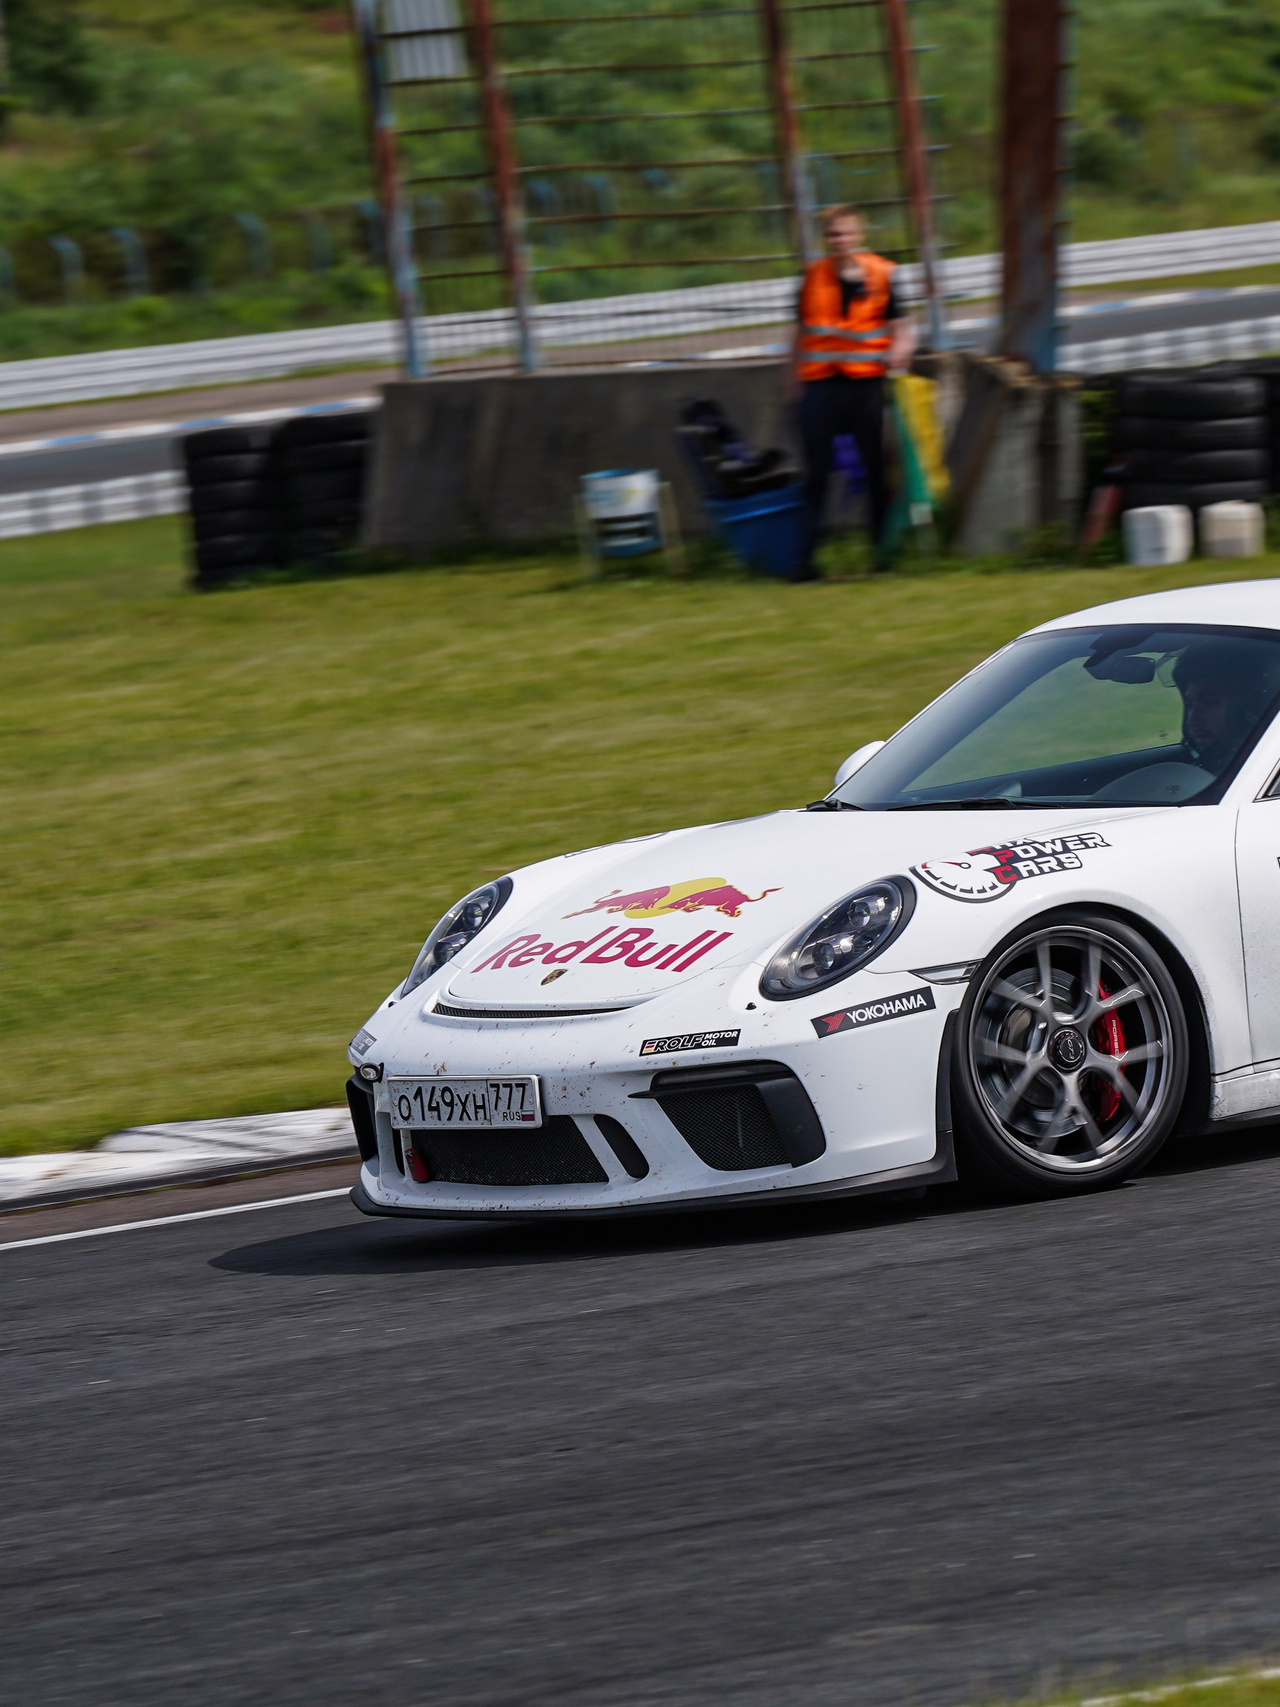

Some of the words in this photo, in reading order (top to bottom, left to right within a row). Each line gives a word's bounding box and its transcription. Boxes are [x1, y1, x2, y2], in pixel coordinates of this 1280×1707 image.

[990, 833, 1111, 863] POWER
[990, 852, 1079, 884] CARS
[846, 994, 927, 1024] YOKOHAMA
[653, 1034, 705, 1053] ROLF
[701, 1039, 717, 1047] OIL
[703, 1030, 738, 1040] MOTOR
[489, 1083, 527, 1110] 777
[502, 1111, 521, 1121] RUS
